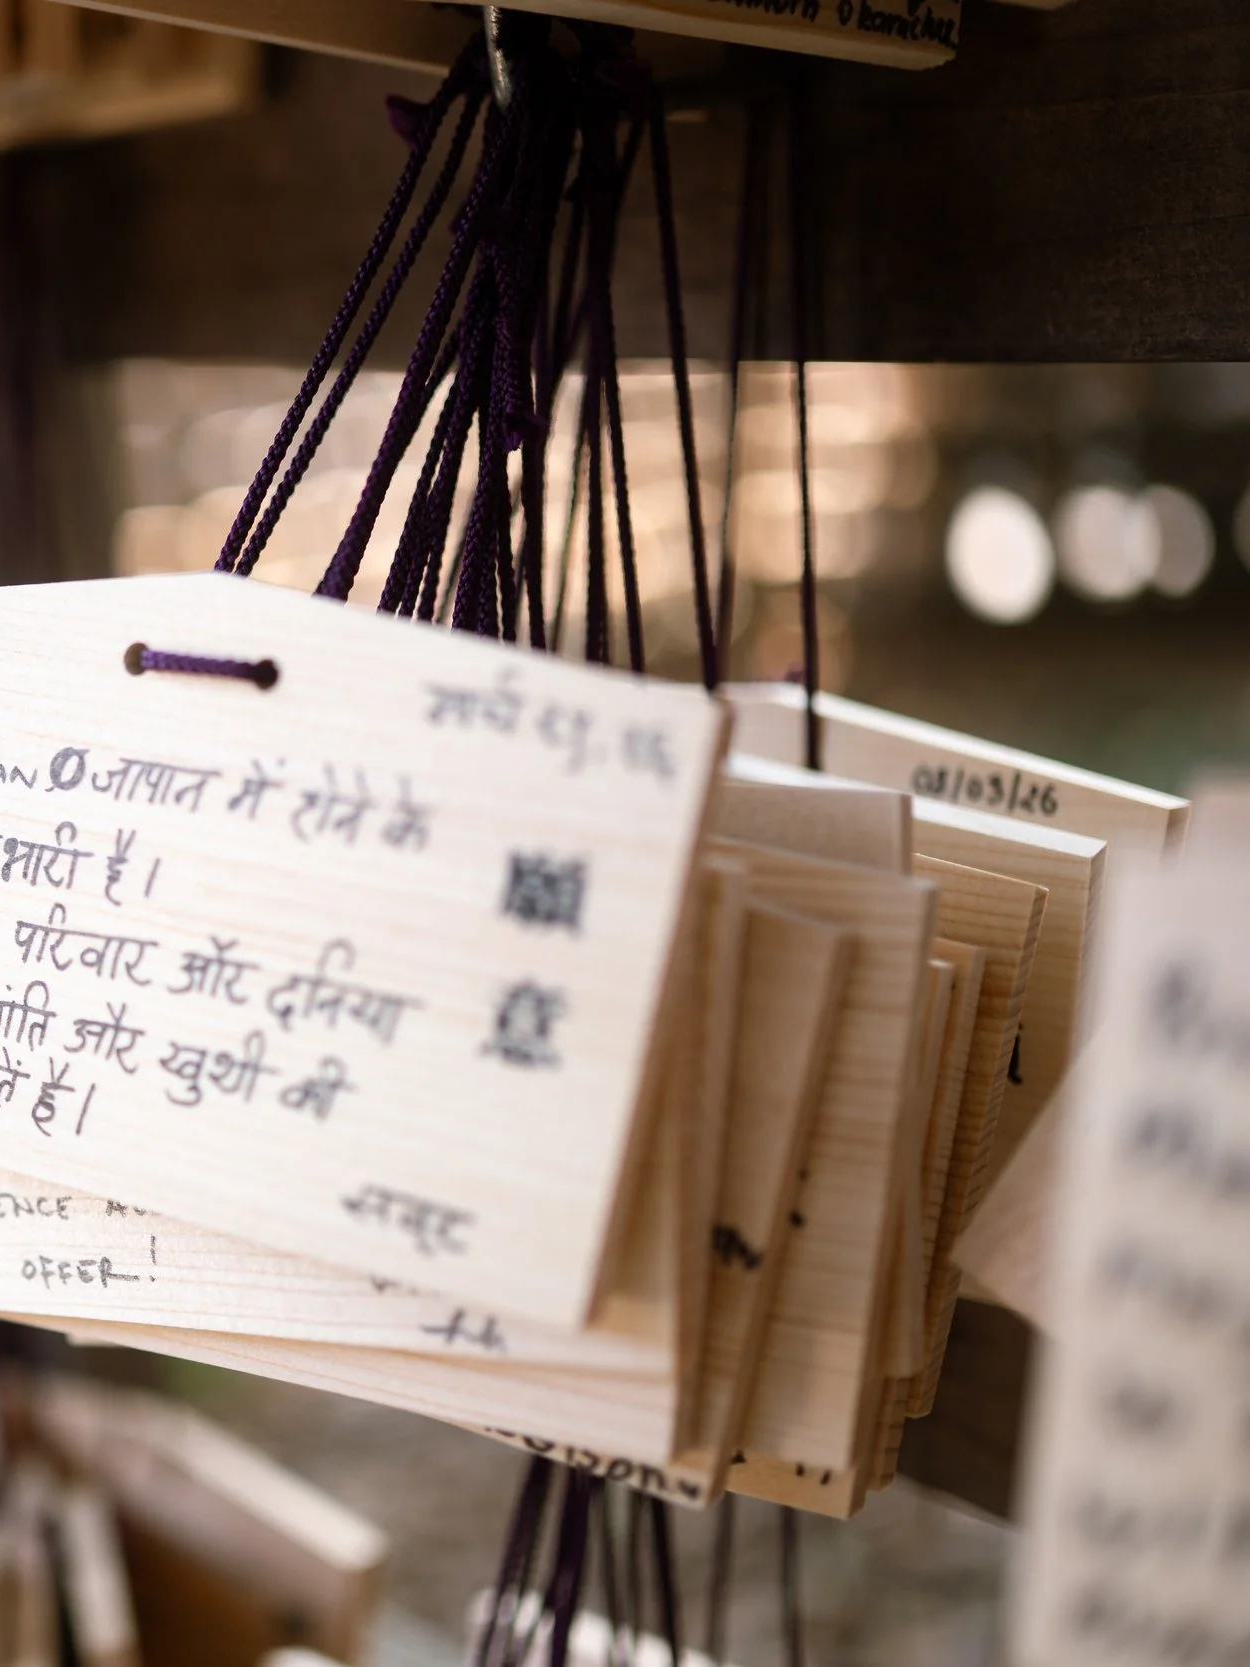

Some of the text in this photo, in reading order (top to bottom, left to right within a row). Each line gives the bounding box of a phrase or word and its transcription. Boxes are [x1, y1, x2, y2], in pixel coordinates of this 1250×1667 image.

[91, 758, 222, 812] जापान
[227, 760, 284, 818] में
[15, 902, 159, 986] परिवार
[63, 1002, 145, 1075] और
